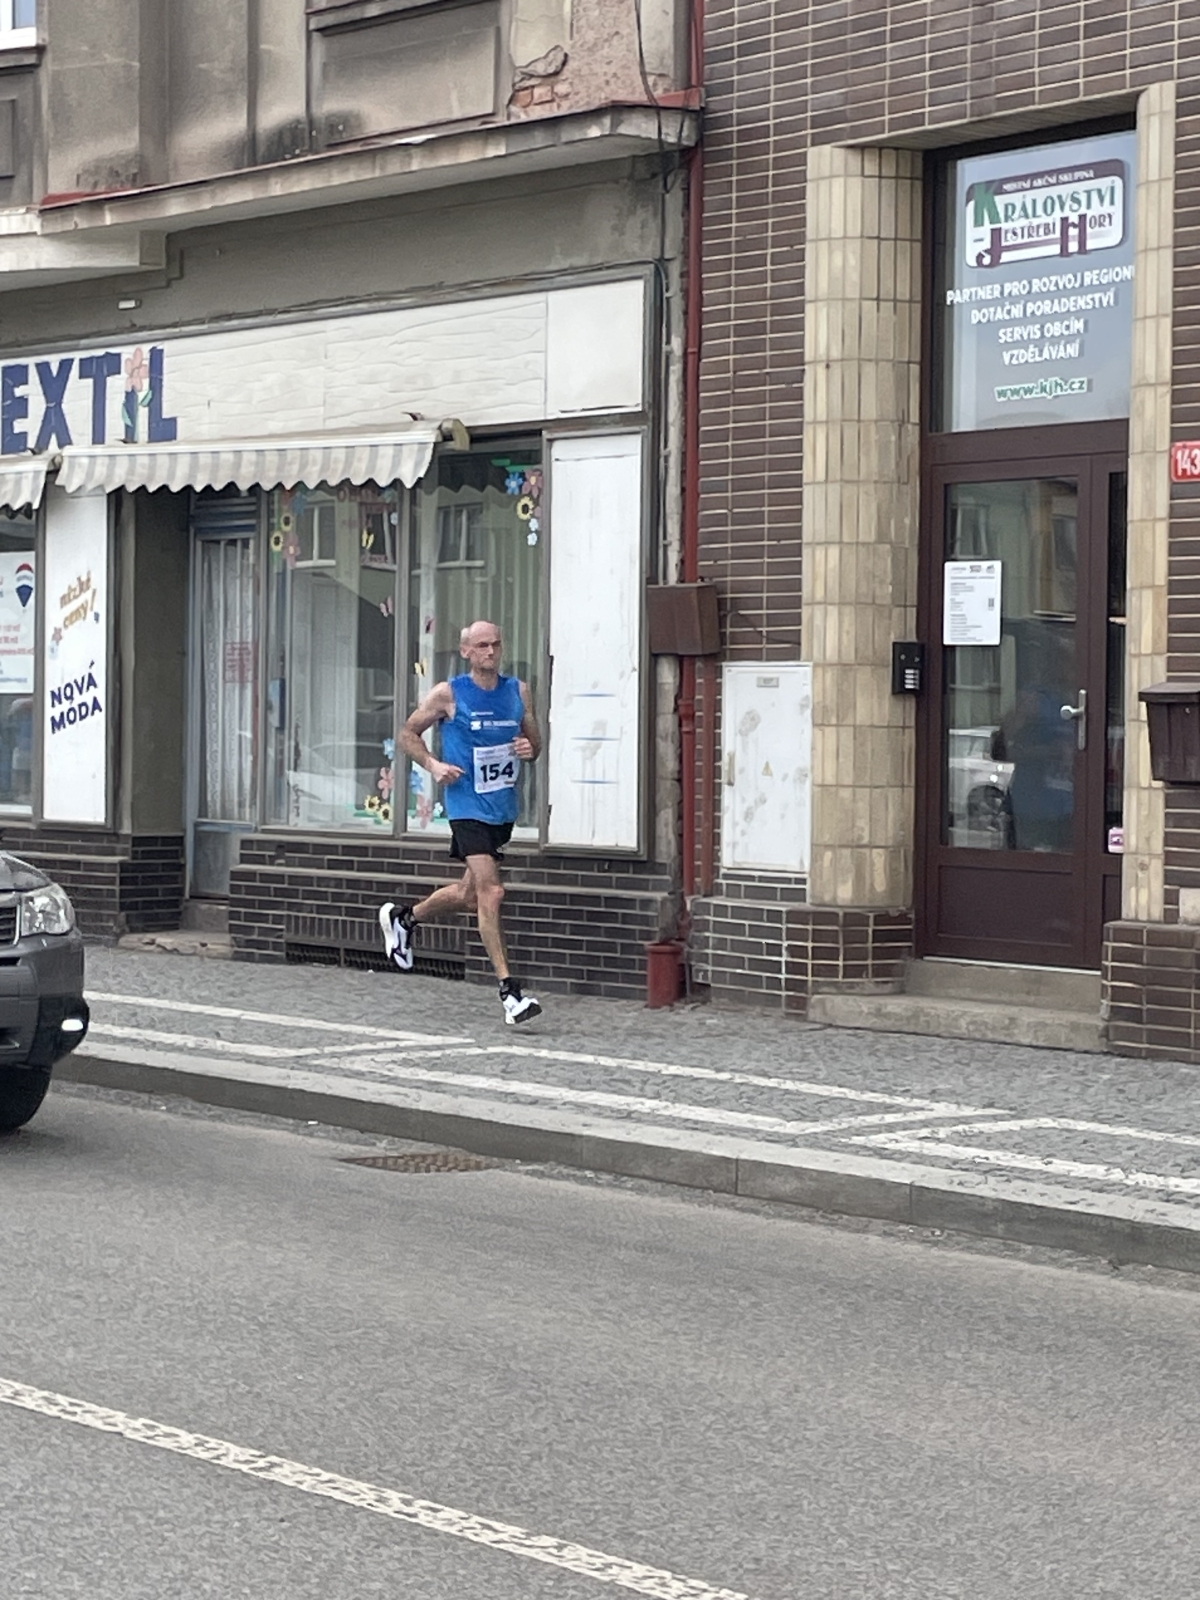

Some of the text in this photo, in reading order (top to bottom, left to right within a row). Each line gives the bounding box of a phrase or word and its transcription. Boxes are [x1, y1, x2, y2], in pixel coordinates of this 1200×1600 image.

[973, 179, 1116, 228] KRÁLOVSTVÍ
[976, 217, 1056, 269] JESTŘEBÍ
[946, 284, 1001, 306] PARTNER
[1003, 281, 1030, 298] PRO
[1031, 272, 1081, 294] ROZVOJ
[971, 287, 1116, 325] DOTAČNÍ PORADENSTVÍ
[998, 316, 1085, 344] SERVIS OBCÍM
[1002, 338, 1080, 366] VZDĚLÁVÁNÍ
[50, 659, 98, 708] NOVÁ
[480, 761, 514, 783] 154
